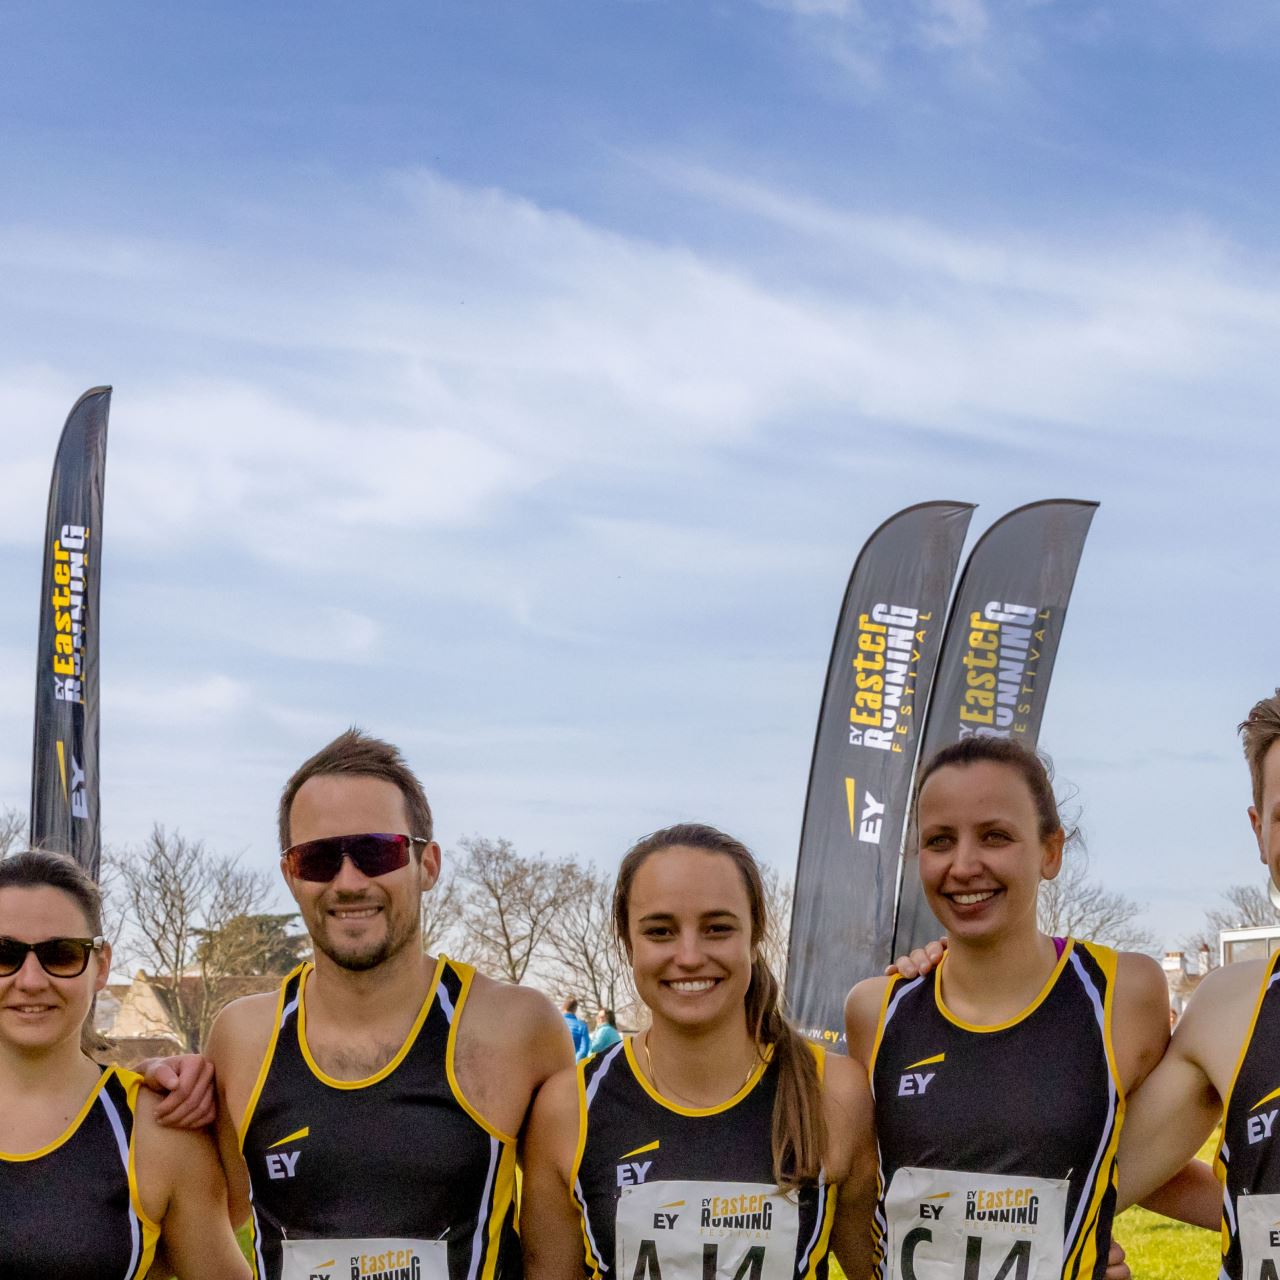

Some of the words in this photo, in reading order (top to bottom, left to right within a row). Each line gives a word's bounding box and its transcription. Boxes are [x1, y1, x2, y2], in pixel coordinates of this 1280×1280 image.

[52, 540, 75, 676] Easter
[61, 524, 85, 703] RUNNING
[850, 613, 887, 727] Easter
[863, 603, 919, 750] RUNNING
[891, 611, 932, 752] FESTIVAL
[960, 611, 1000, 725] Easter
[1014, 609, 1050, 733] ESTIVAL
[54, 676, 66, 701] EY
[849, 725, 863, 746] EY
[72, 753, 89, 819] EY
[858, 790, 886, 845] EY
[897, 1072, 936, 1097] EY
[1247, 1108, 1279, 1145] EY
[265, 1151, 301, 1179] EY
[616, 1161, 653, 1186] EY
[701, 1198, 711, 1207] EY
[712, 1194, 768, 1216] Easter
[919, 1203, 945, 1220] EY
[965, 1196, 1039, 1225] RUNNING
[967, 1190, 977, 1200] EY
[977, 1187, 1034, 1210] Easter
[653, 1213, 680, 1230] EY
[701, 1201, 772, 1230] RUNNING
[963, 1220, 1038, 1234] FESTIVAL
[699, 1229, 770, 1239] FESTIVAL
[351, 1256, 360, 1266] EY
[361, 1248, 413, 1274] Easter
